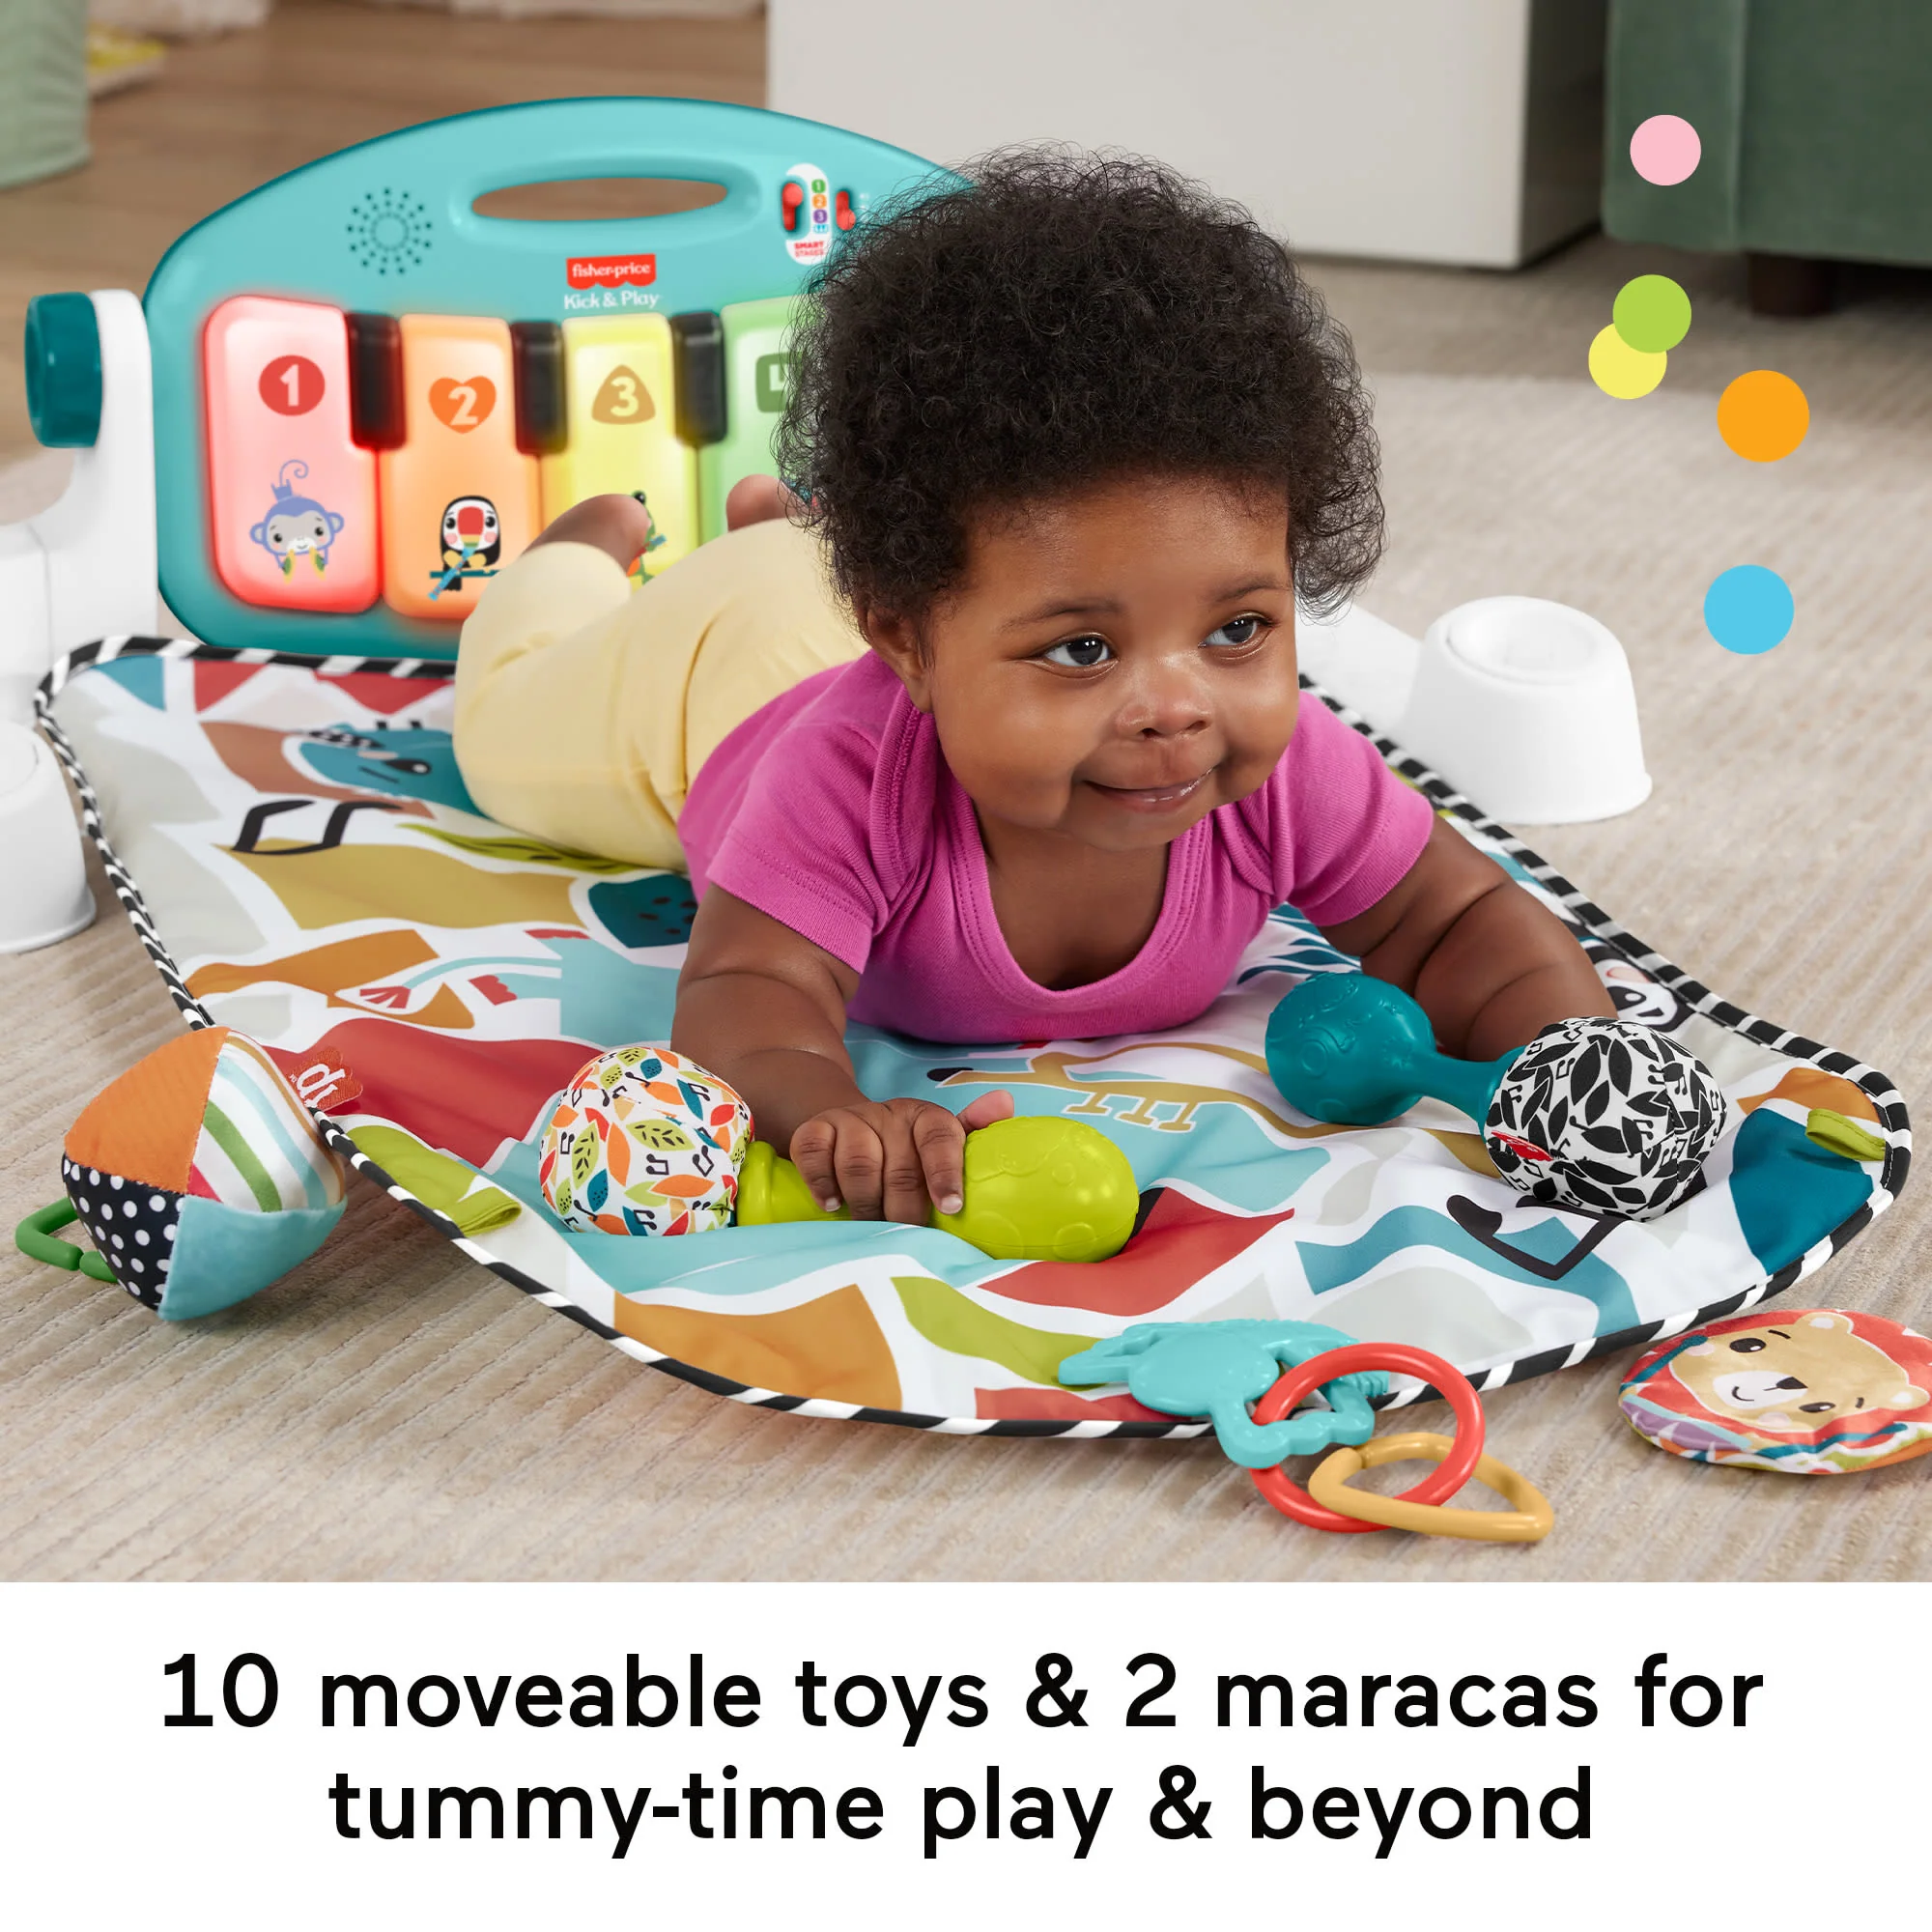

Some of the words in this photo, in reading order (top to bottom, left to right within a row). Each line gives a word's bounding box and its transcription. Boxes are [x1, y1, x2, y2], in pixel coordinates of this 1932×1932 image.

[572, 262, 651, 279] fisher-price
[564, 293, 600, 310] Kick
[603, 292, 619, 308] &
[621, 289, 660, 309] Play
[279, 363, 299, 407] 1
[447, 385, 478, 426] 2
[610, 376, 639, 417] 3
